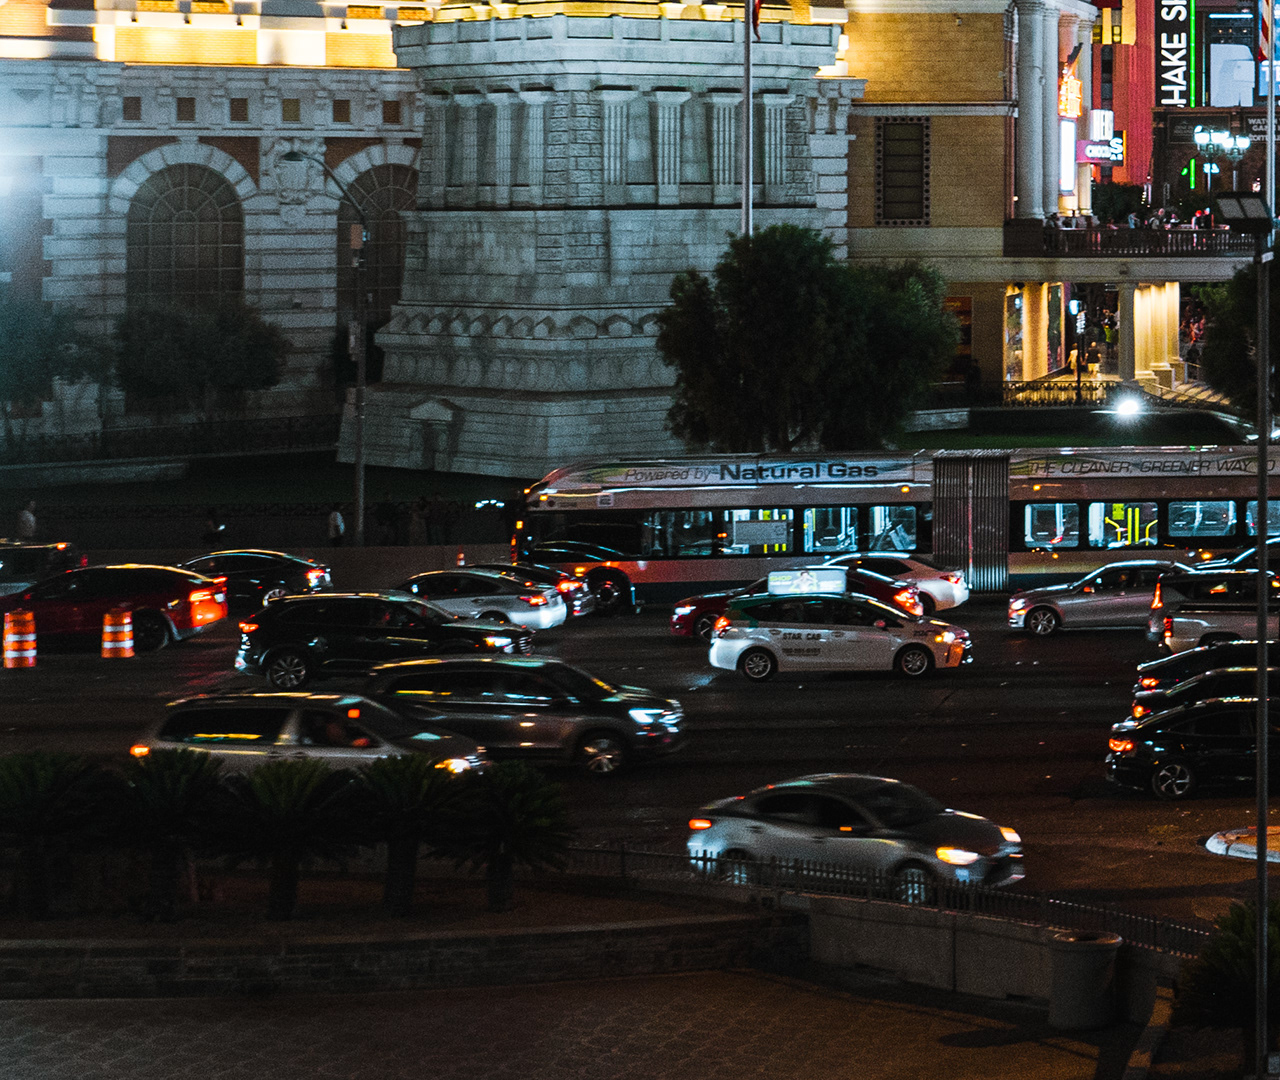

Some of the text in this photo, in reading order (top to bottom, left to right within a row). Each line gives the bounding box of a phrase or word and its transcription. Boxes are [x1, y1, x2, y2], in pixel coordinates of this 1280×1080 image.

[1161, 43, 1187, 108] HAKE
[624, 462, 878, 484] Powered by Natural Gas
[1030, 461, 1059, 474] THE
[1141, 460, 1210, 472] GREENER
[1217, 459, 1251, 471] WAY
